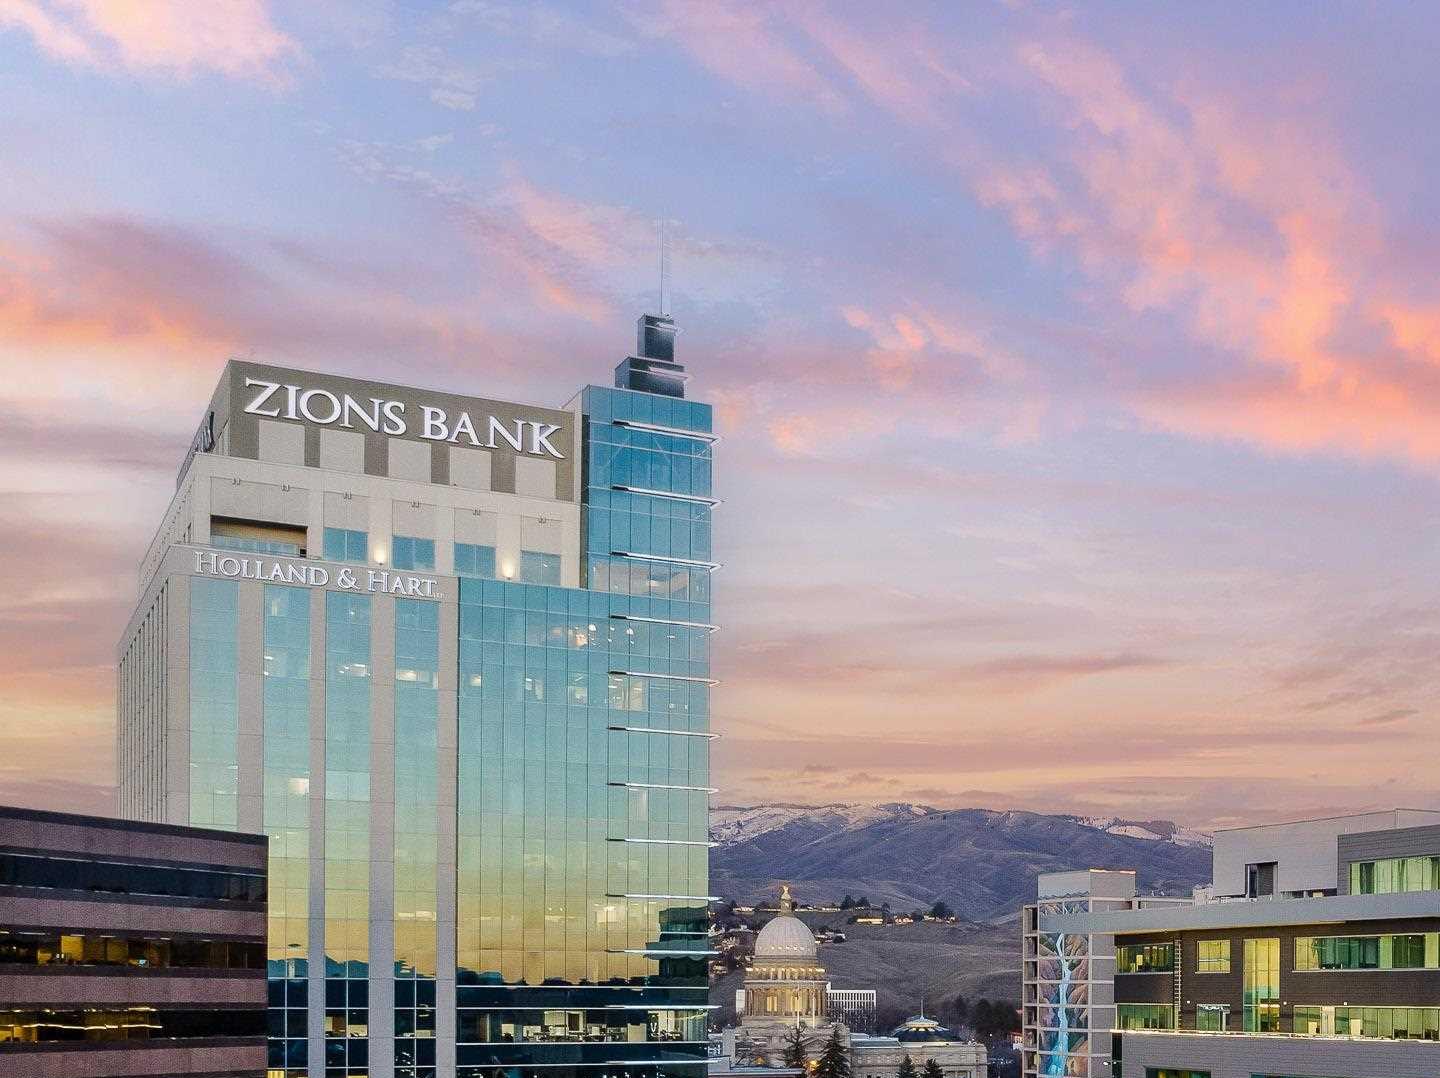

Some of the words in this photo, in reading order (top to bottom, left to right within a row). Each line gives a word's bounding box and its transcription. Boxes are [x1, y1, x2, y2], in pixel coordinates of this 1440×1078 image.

[243, 377, 407, 436] ZIONS
[418, 405, 566, 459] BANK
[194, 551, 329, 586] HOLLAND
[337, 568, 361, 590] &
[367, 570, 437, 597] HART
